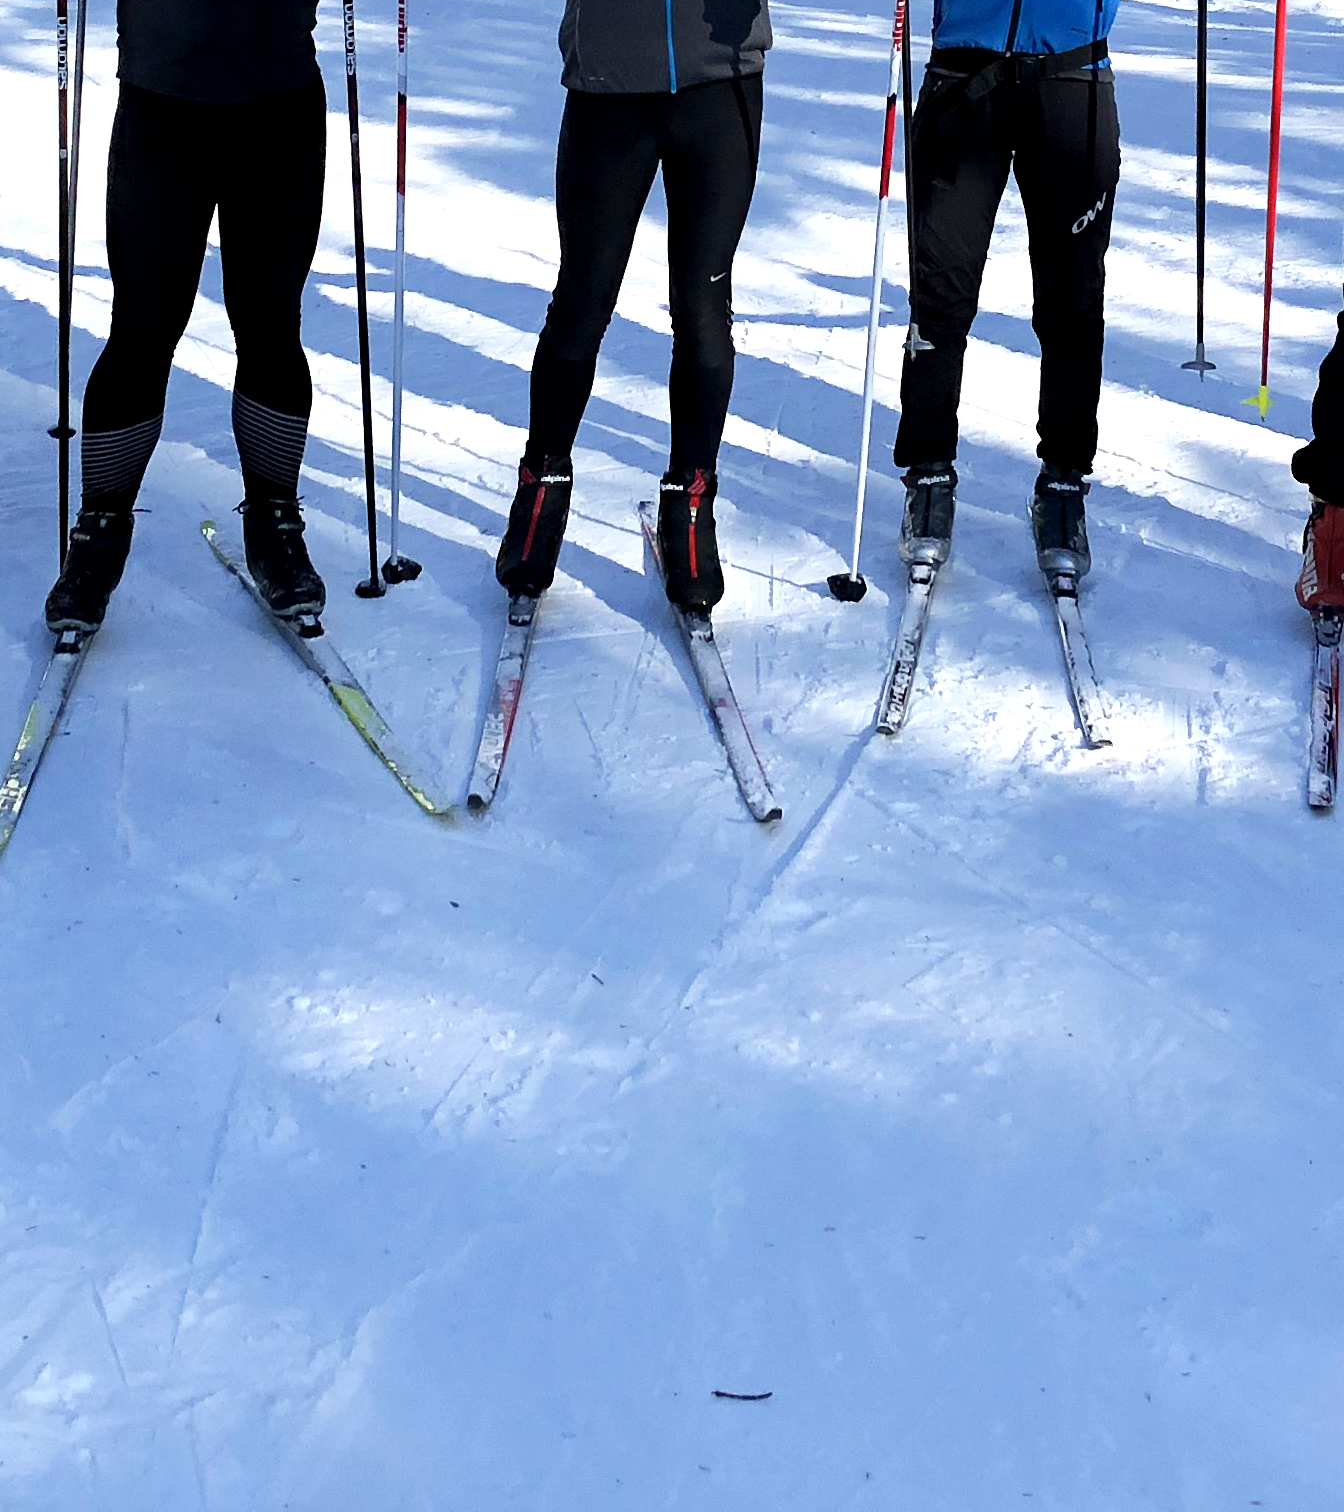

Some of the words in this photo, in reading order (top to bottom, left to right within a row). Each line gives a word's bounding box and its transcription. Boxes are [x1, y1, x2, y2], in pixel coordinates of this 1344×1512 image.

[541, 474, 571, 484] alpina
[917, 474, 950, 485] alpina
[661, 483, 684, 491] lpina
[1048, 481, 1080, 491] alpina
